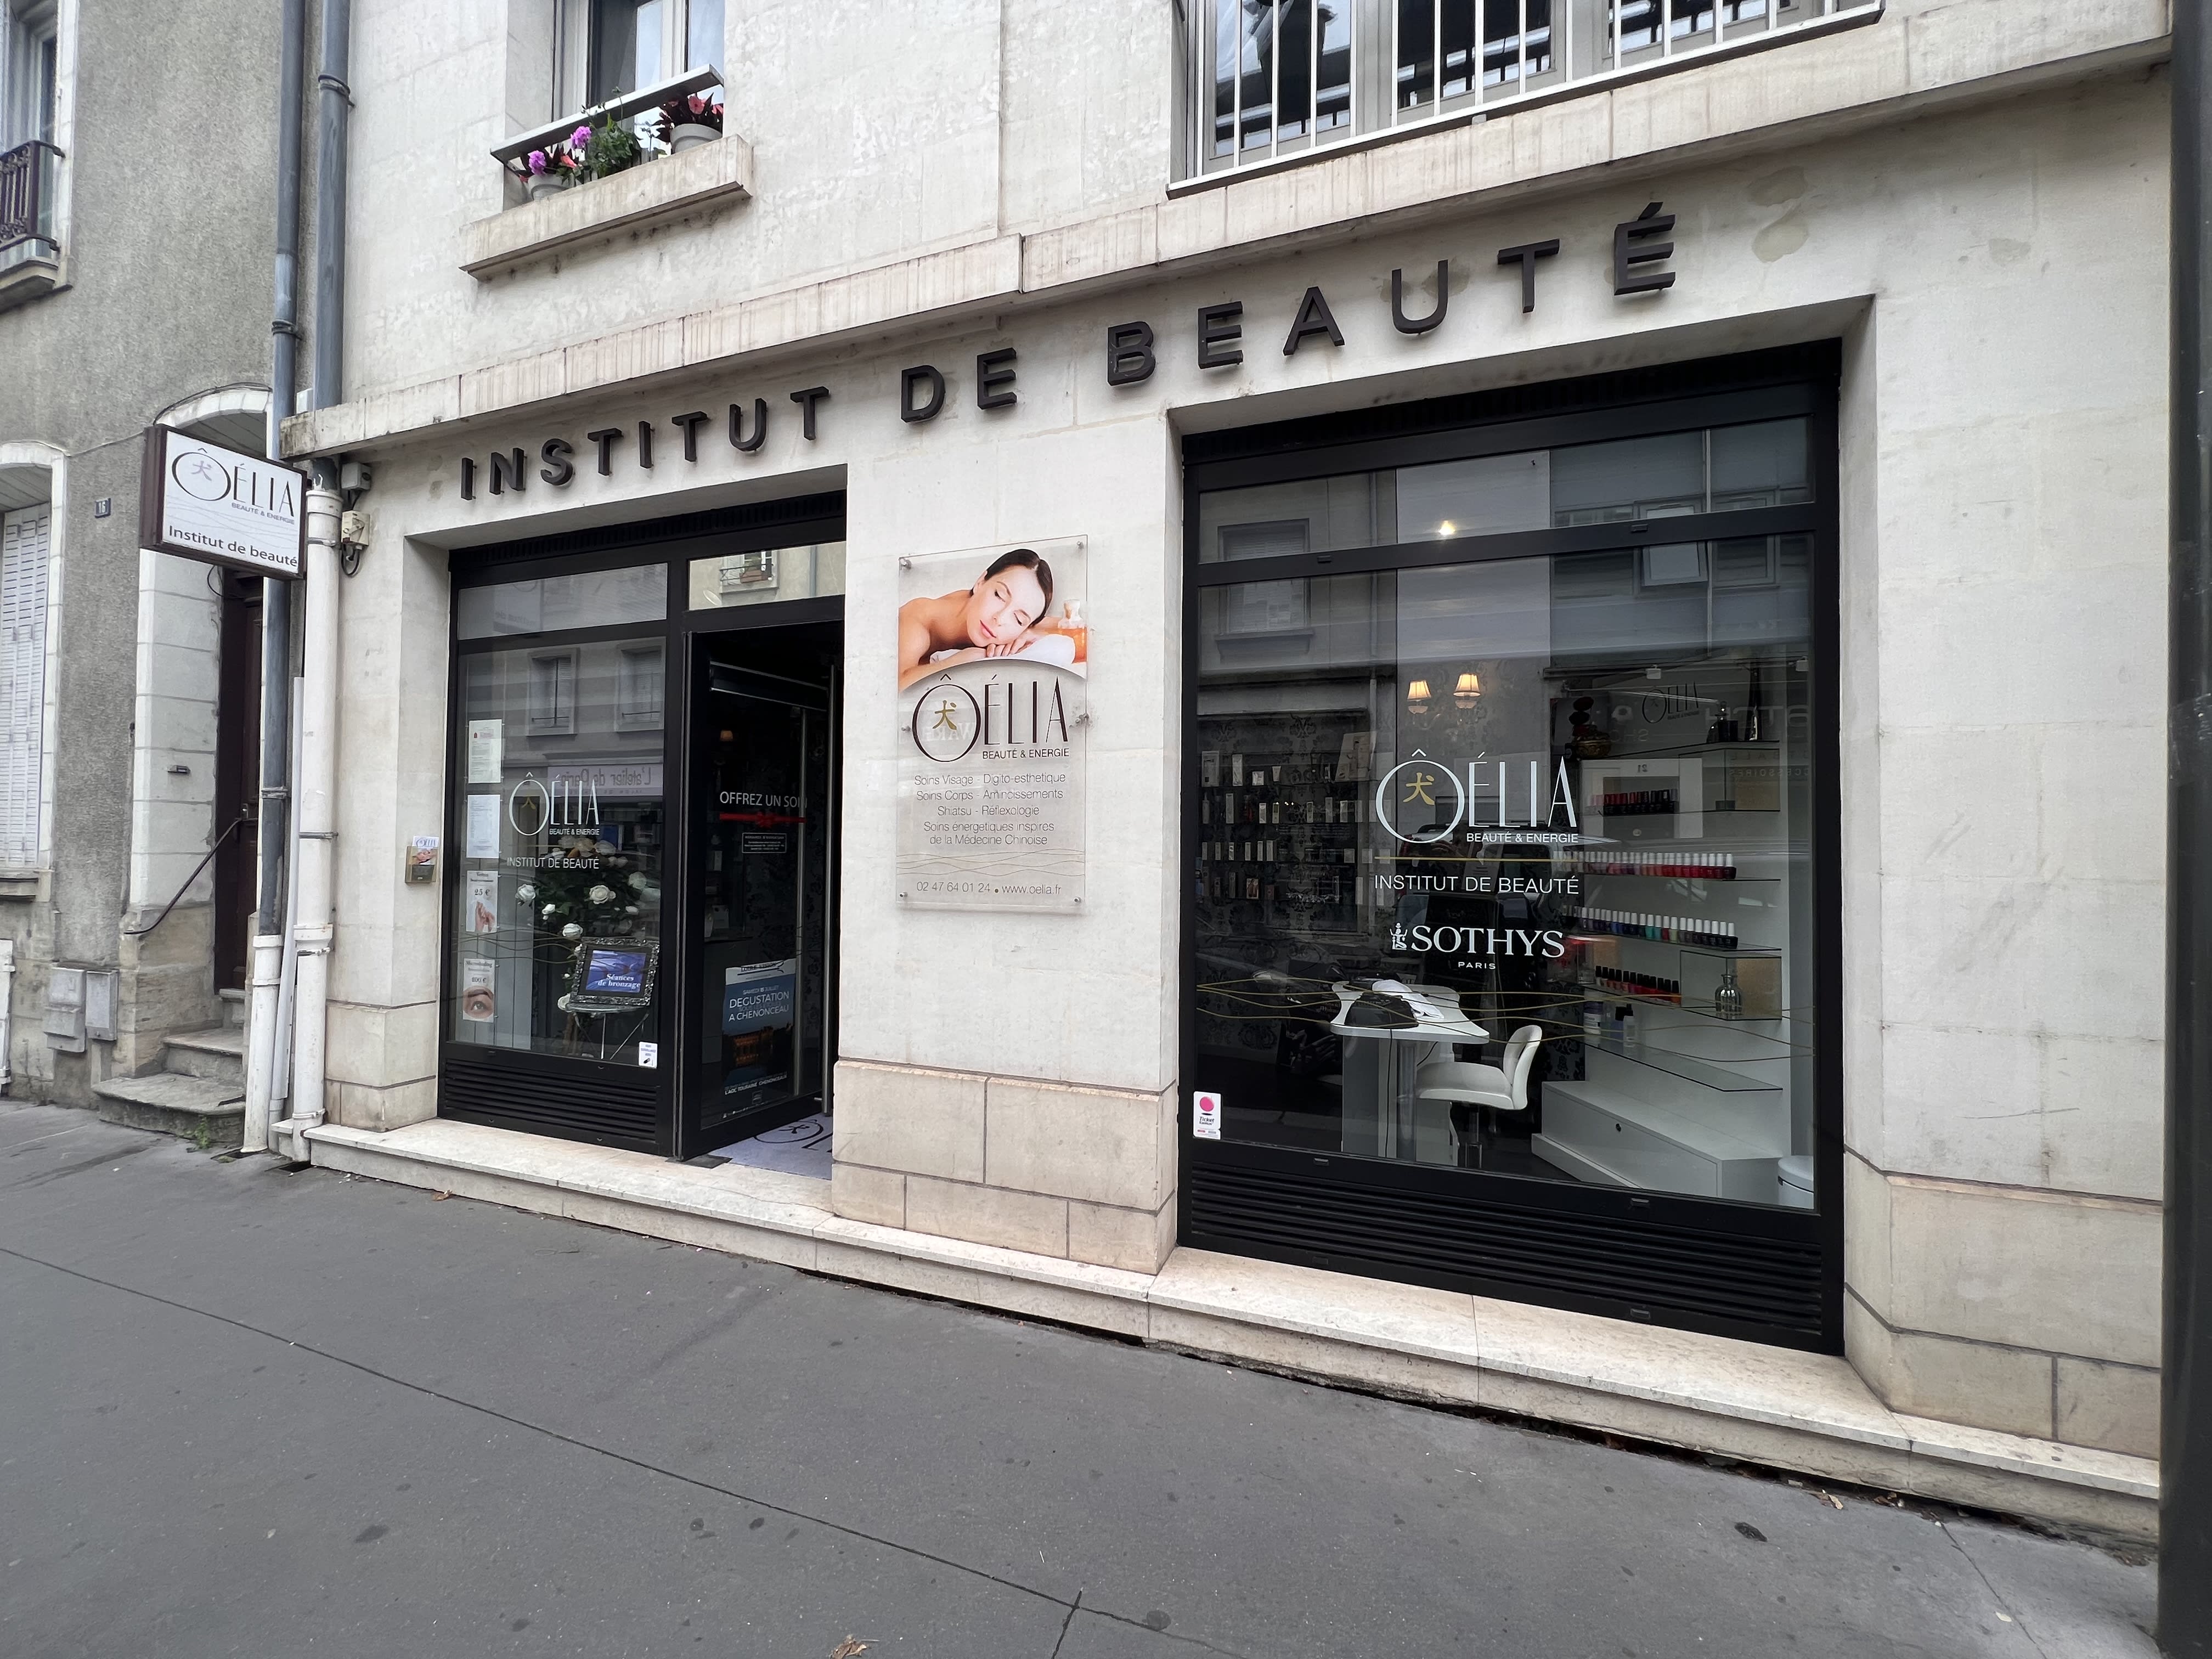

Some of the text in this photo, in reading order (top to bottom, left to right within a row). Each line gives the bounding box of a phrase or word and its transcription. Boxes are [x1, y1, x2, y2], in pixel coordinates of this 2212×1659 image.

[461, 202, 1675, 500] INSTITUT DE BEAUTÉ
[232, 503, 258, 514] BEAUTÉ
[169, 525, 297, 567] Institut de beauté
[983, 748, 1069, 759] BEAUTÉ & ENERGIE
[915, 775, 939, 786] Soins
[943, 774, 973, 786] Visage
[720, 791, 763, 806] OFFREZ
[765, 794, 781, 806] UN
[917, 791, 942, 801] Soins
[945, 790, 973, 801] Corps
[983, 789, 1063, 799] Amincissements
[938, 805, 972, 816] Shiatsu
[923, 821, 949, 832] Soins
[930, 833, 1047, 845] de la Médecine Chinoise
[1467, 831, 1578, 843] BEAUTÉ & ENERGIE
[507, 856, 599, 869] INSTITUT DE BEAUTÉ
[917, 881, 929, 891] 02
[932, 882, 944, 891] 47
[947, 882, 958, 892] 64
[962, 882, 973, 892] 01
[978, 883, 990, 893] 24
[1375, 875, 1579, 894] INSTITUT DE BEAUTÉ
[1411, 925, 1565, 958] SOTHYS
[1458, 961, 1496, 970] PARIS
[606, 973, 634, 981] Séances
[608, 980, 641, 989] bronzage
[730, 991, 789, 1008] DEGUSTATION
